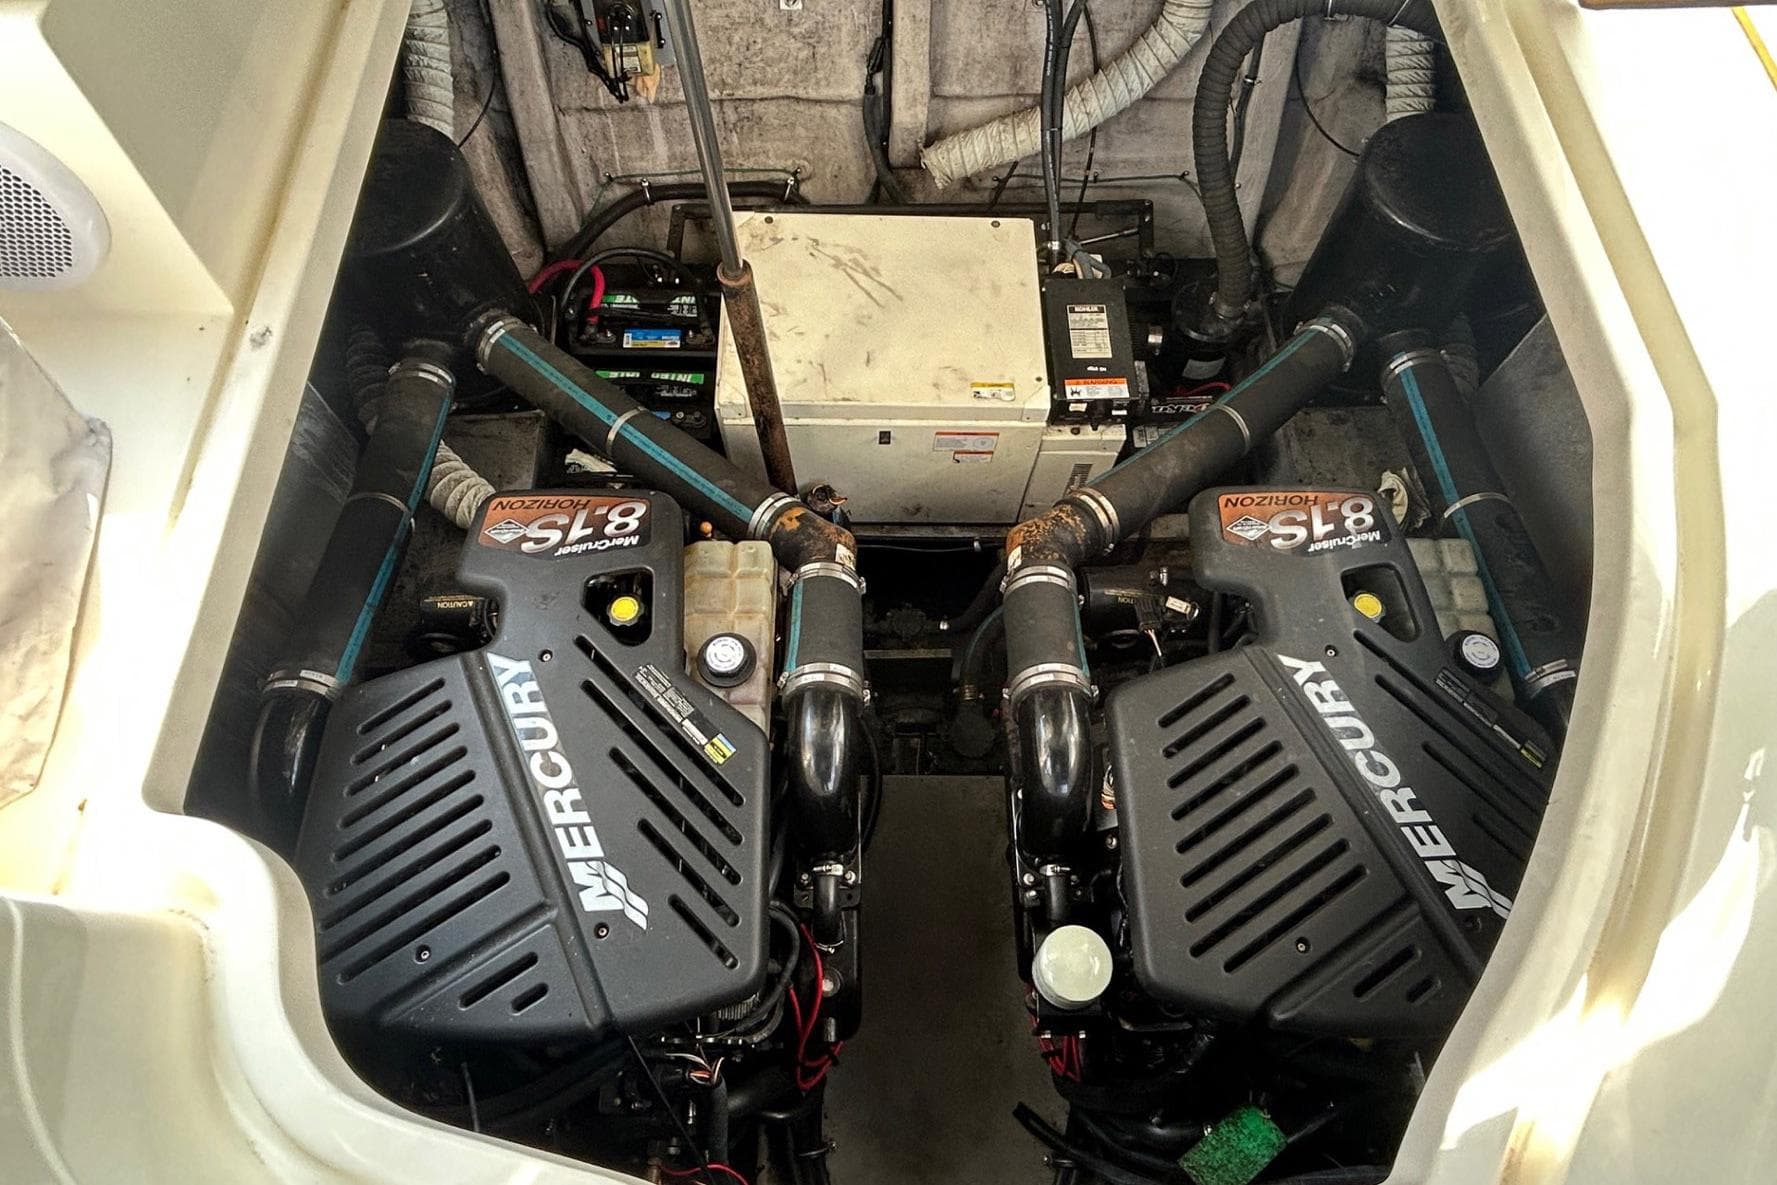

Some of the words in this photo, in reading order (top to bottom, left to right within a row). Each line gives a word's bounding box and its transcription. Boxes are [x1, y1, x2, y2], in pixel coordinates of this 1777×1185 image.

[492, 498, 591, 511] HORIZON
[1224, 495, 1319, 507] HORIZON
[520, 501, 647, 554] 8.1S
[1268, 496, 1374, 550] 8.1S
[553, 534, 640, 557] MerCruiser
[1308, 530, 1380, 553] MerCruiser
[437, 600, 468, 609] CAUTION
[487, 653, 648, 930] MERCURY
[1276, 653, 1510, 918] MERCURY
